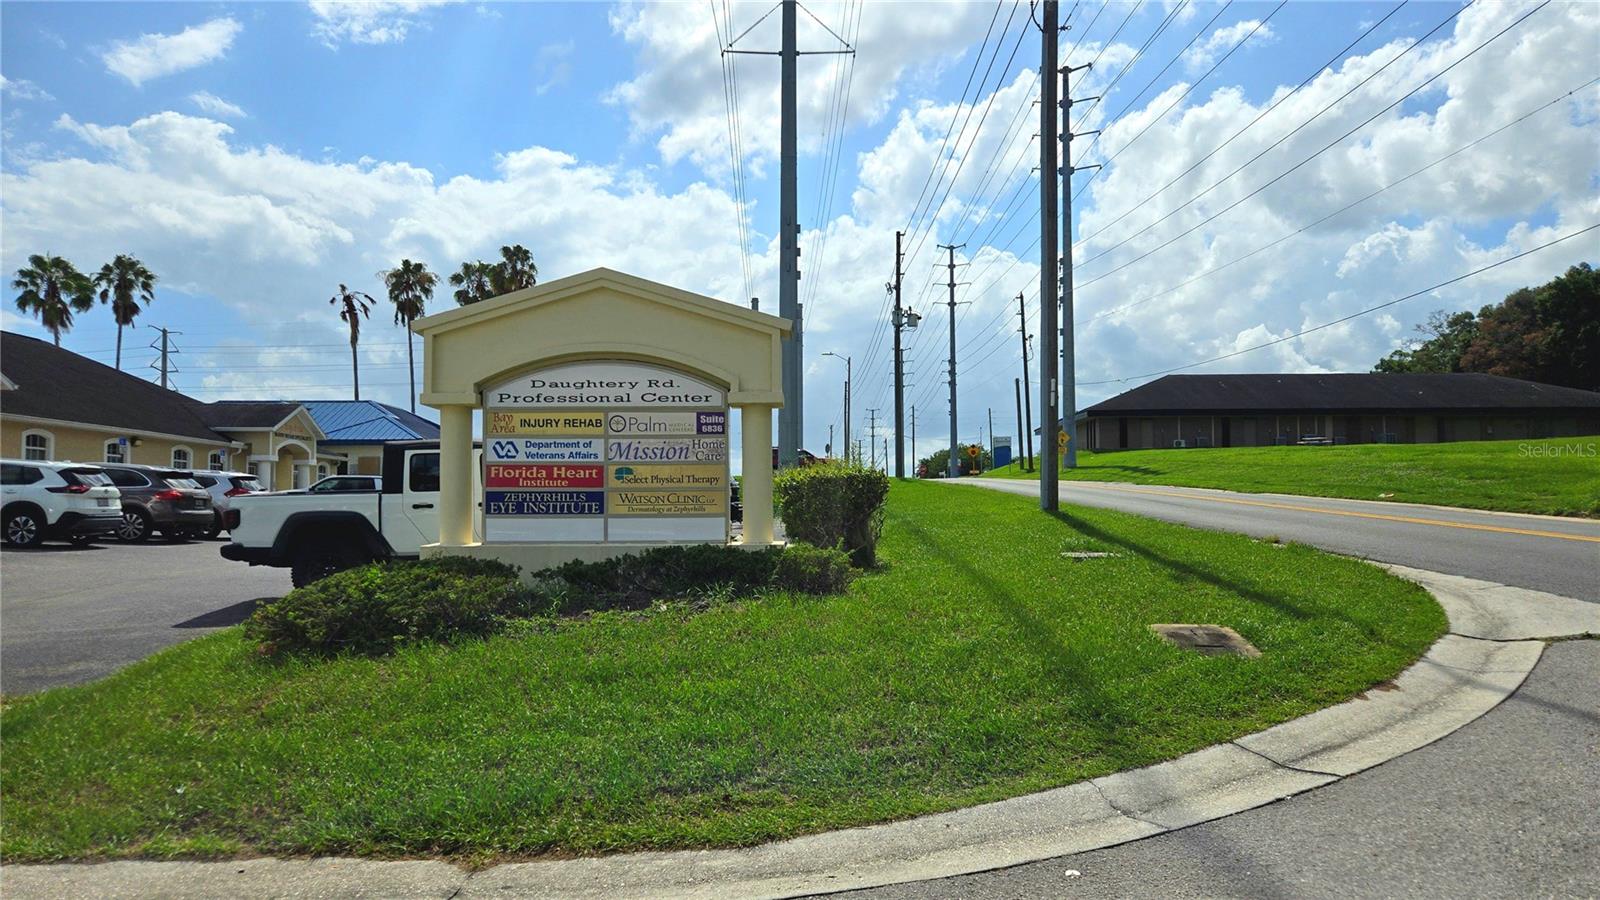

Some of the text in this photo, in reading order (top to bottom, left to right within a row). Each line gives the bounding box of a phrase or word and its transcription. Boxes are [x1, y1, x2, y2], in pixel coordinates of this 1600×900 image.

[530, 379, 681, 391] Daughtery Rd.
[498, 393, 713, 404] Professional Center
[492, 412, 514, 425] Bay
[519, 418, 603, 428] INJURY REHAB
[628, 416, 667, 432] Palm
[700, 415, 724, 424] Suite
[491, 423, 516, 433] Area
[702, 424, 723, 433] 6836
[525, 440, 592, 450] Department of
[607, 440, 689, 461] Mission
[692, 440, 725, 450] Home
[525, 451, 599, 459] Veterans Affairs
[695, 450, 721, 461] Care
[490, 466, 598, 478] Florida Heart
[519, 478, 569, 487] Institute
[624, 474, 720, 486] Select Physical Therapy
[504, 493, 586, 502] ZEPHYRHILLS
[619, 493, 665, 504] WATSON
[666, 493, 706, 504] CLINIC
[490, 502, 600, 514] EYE INSTITUTE
